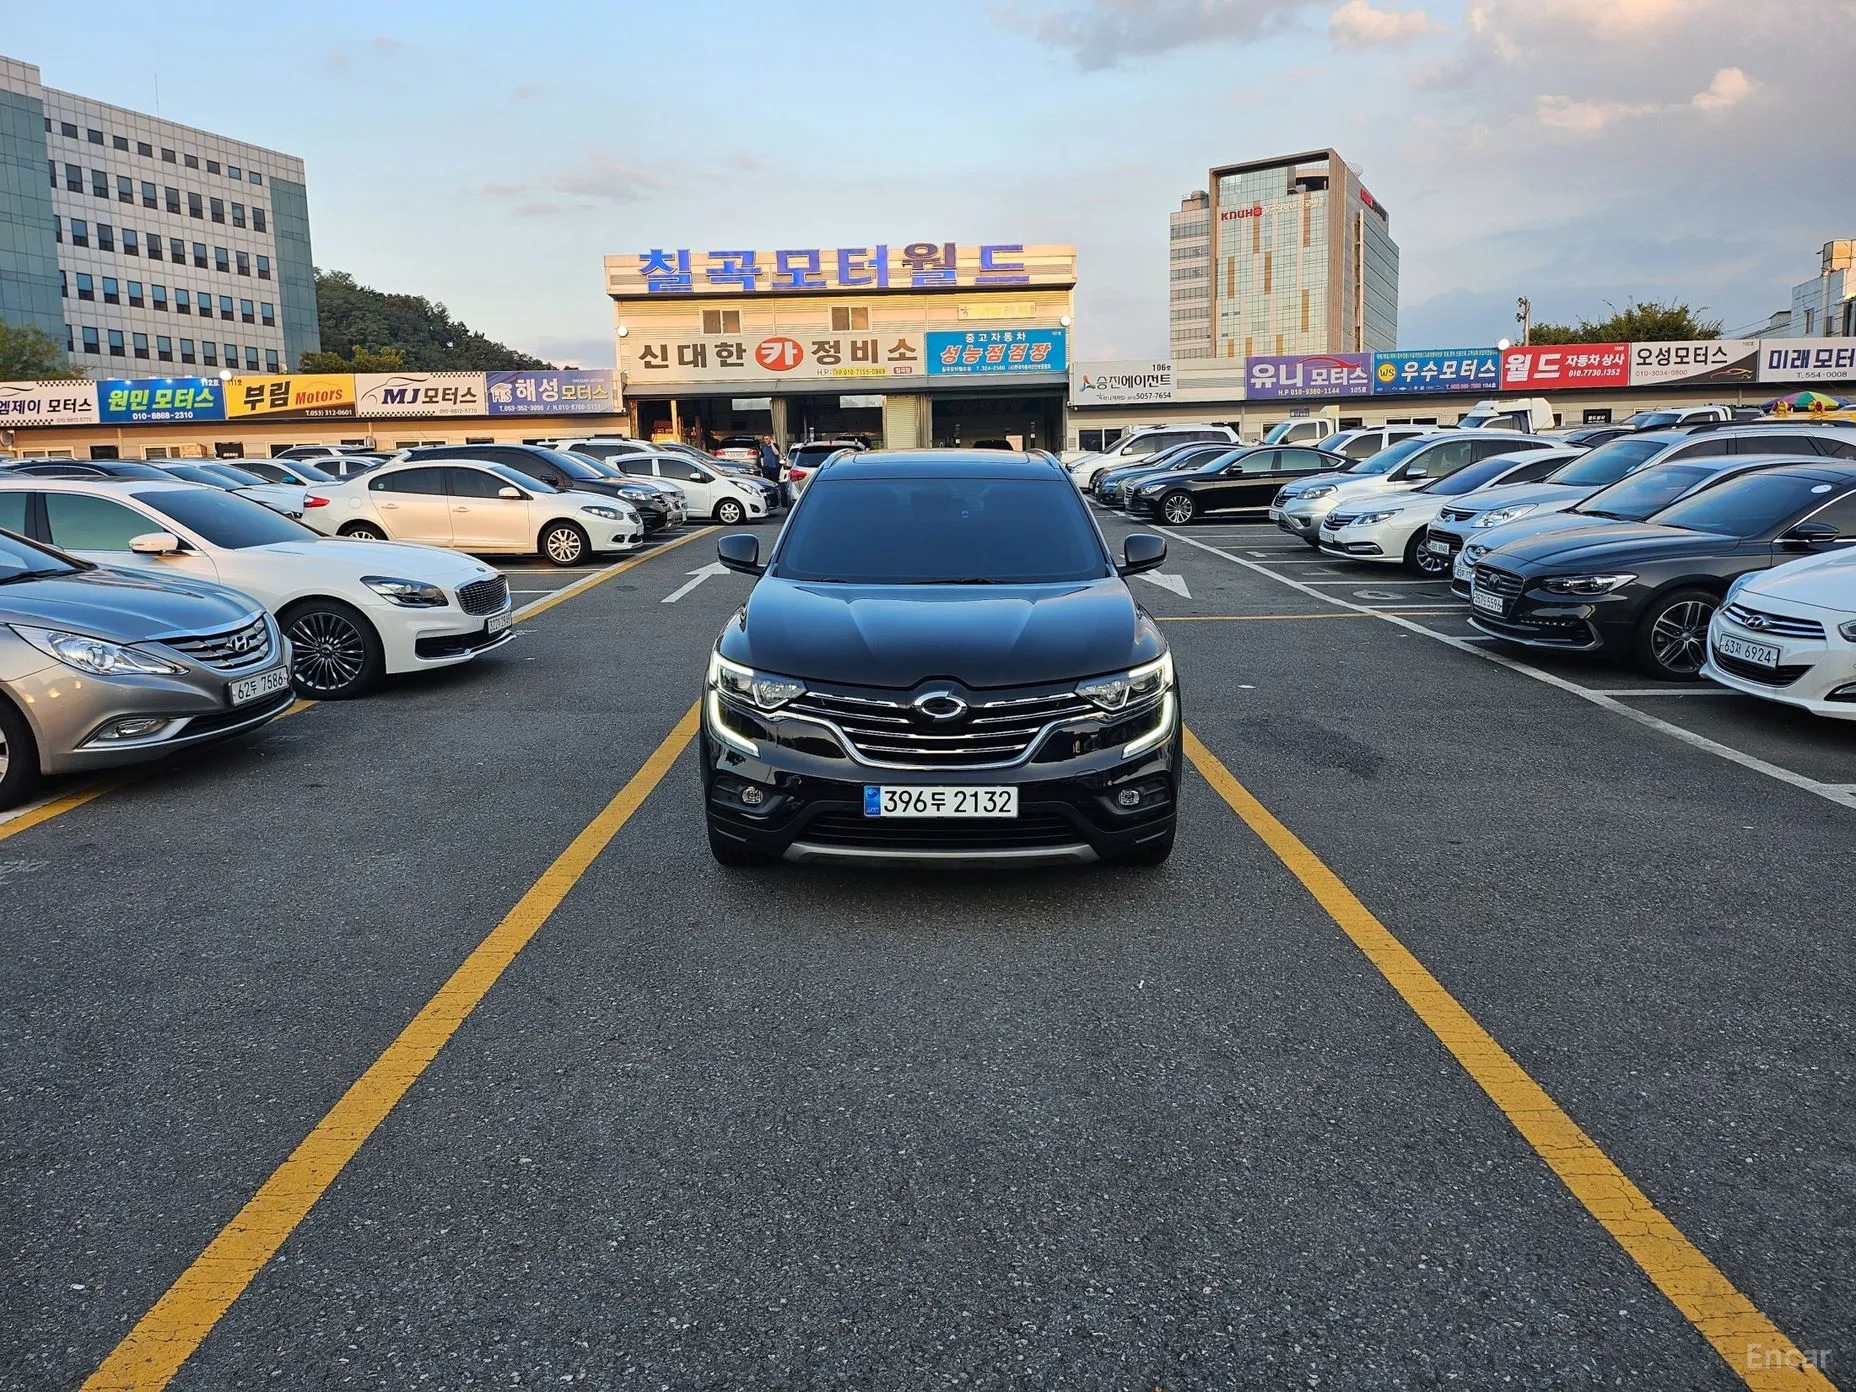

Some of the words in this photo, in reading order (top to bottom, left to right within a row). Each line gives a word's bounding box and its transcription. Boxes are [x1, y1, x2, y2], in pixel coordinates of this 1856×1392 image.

[639, 242, 1031, 293] 칠곡모터월드
[965, 332, 1026, 343] 중고자동차
[940, 342, 1051, 364] 성능점검장
[1636, 346, 1728, 366] 오성모터스
[1251, 363, 1303, 389] 유니
[1310, 367, 1368, 385] 모터스
[1380, 368, 1395, 378] WS
[1400, 359, 1497, 383] 우수모터스
[1505, 353, 1562, 382] 월드
[1565, 354, 1600, 367] 자동차
[1602, 353, 1625, 366] 상사
[1568, 368, 1621, 377] 010.7730.1352
[108, 389, 150, 411] 원민
[152, 388, 214, 409] 모터스
[244, 381, 291, 411] 부림
[295, 389, 343, 405] Motors
[515, 378, 559, 402] 해성
[561, 384, 608, 401] 모터스
[0, 399, 41, 415] 엠제이
[47, 398, 92, 413] 모터스
[1744, 644, 1772, 664] 6924
[260, 671, 284, 692] 7586
[883, 790, 946, 813] 396두
[953, 790, 1012, 813] 2132
